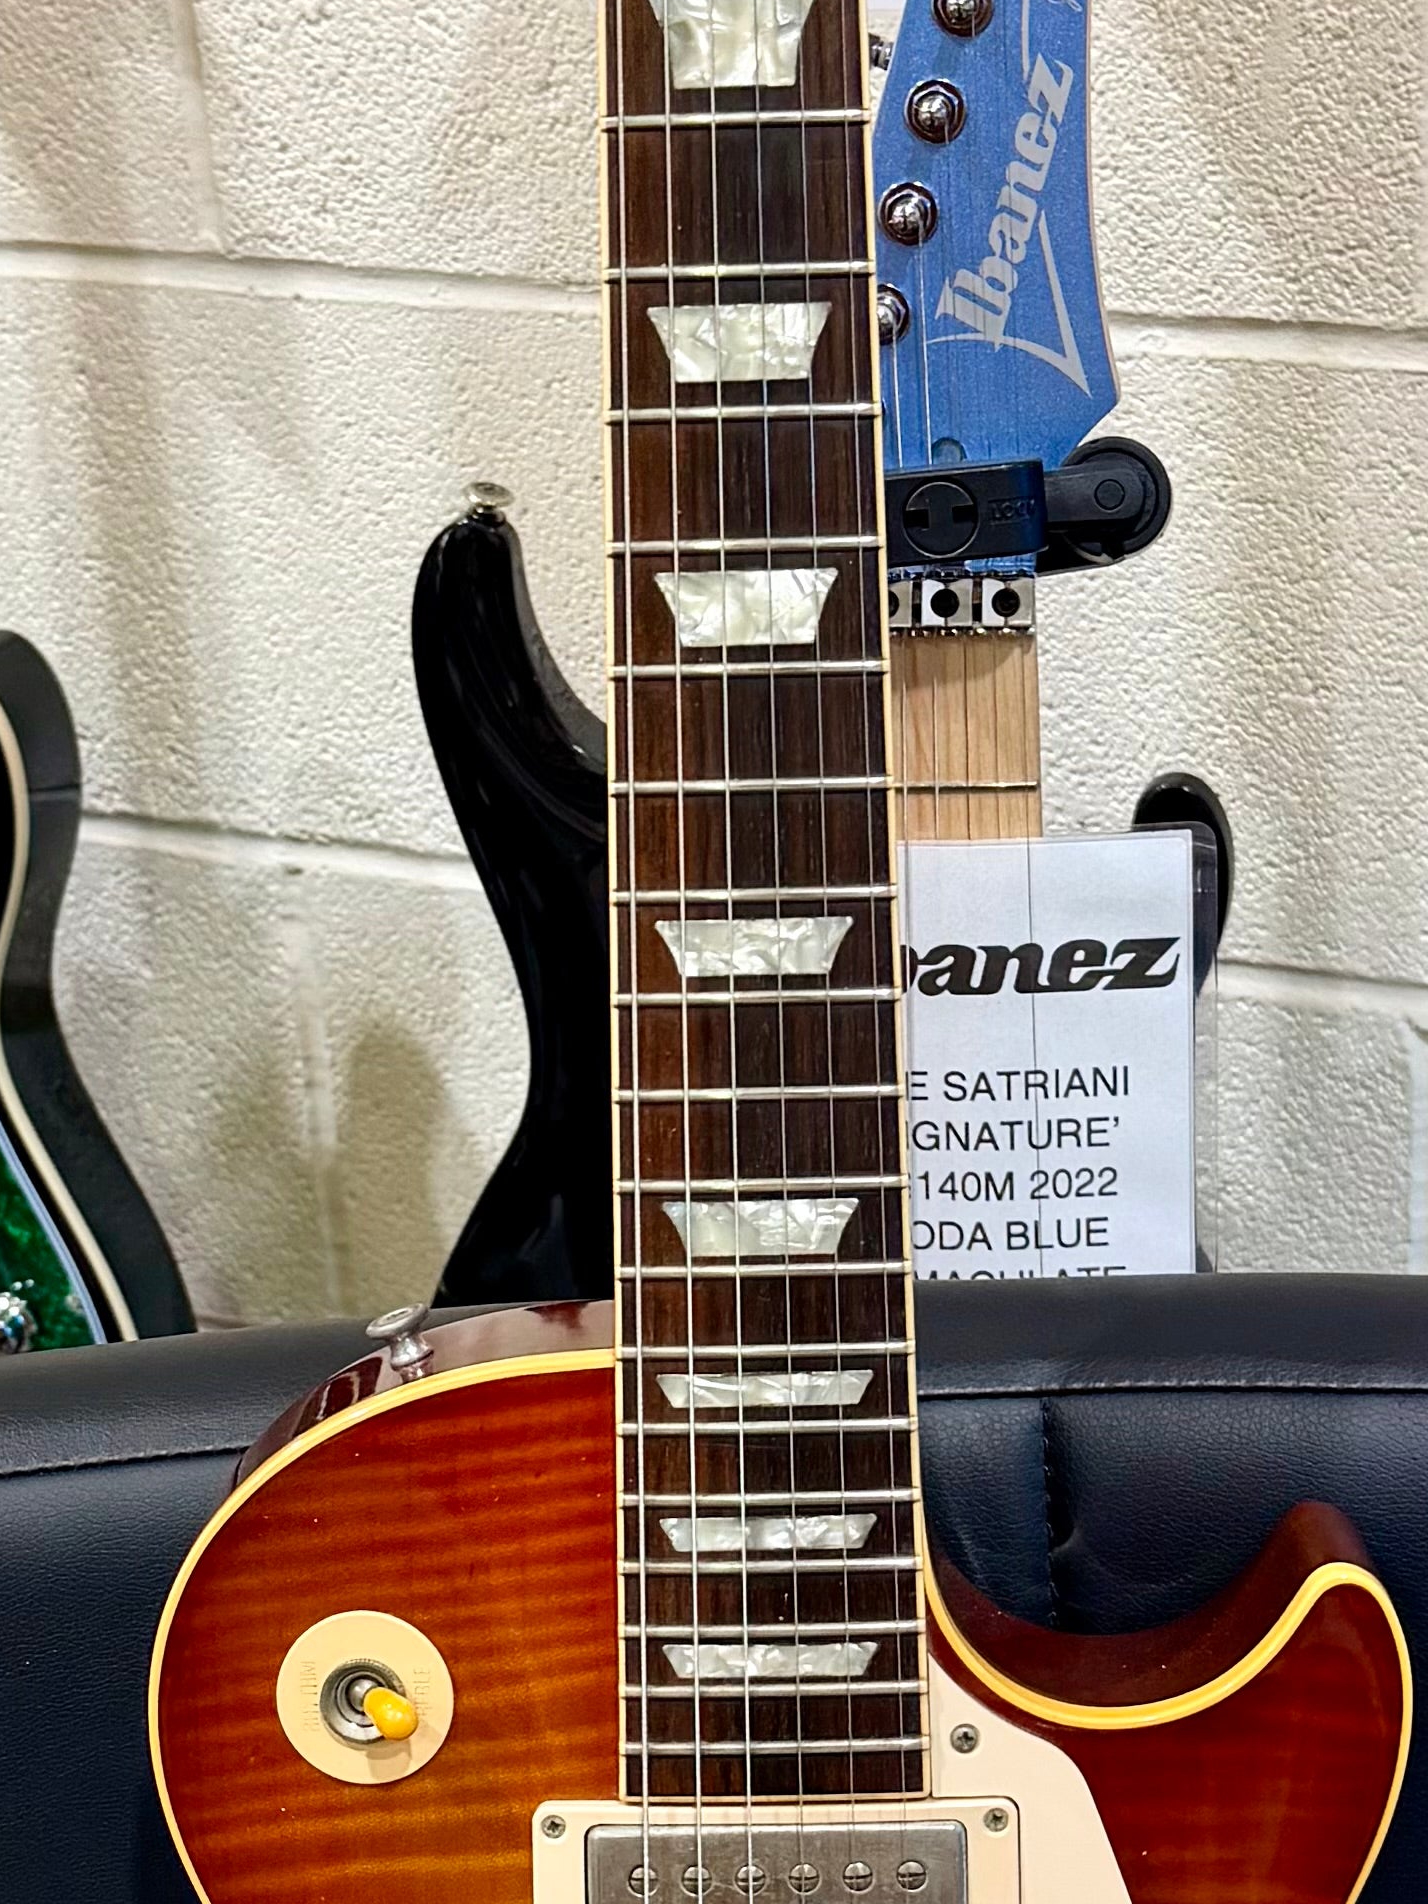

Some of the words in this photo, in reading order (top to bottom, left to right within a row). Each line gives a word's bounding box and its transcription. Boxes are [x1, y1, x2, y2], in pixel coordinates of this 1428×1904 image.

[935, 52, 1074, 352] Ibanez
[943, 1065, 1130, 1102] SATRIANI
[908, 1170, 1015, 1202] 140M
[1029, 1167, 1120, 1201] 2022
[1007, 1217, 1110, 1251] BLUE
